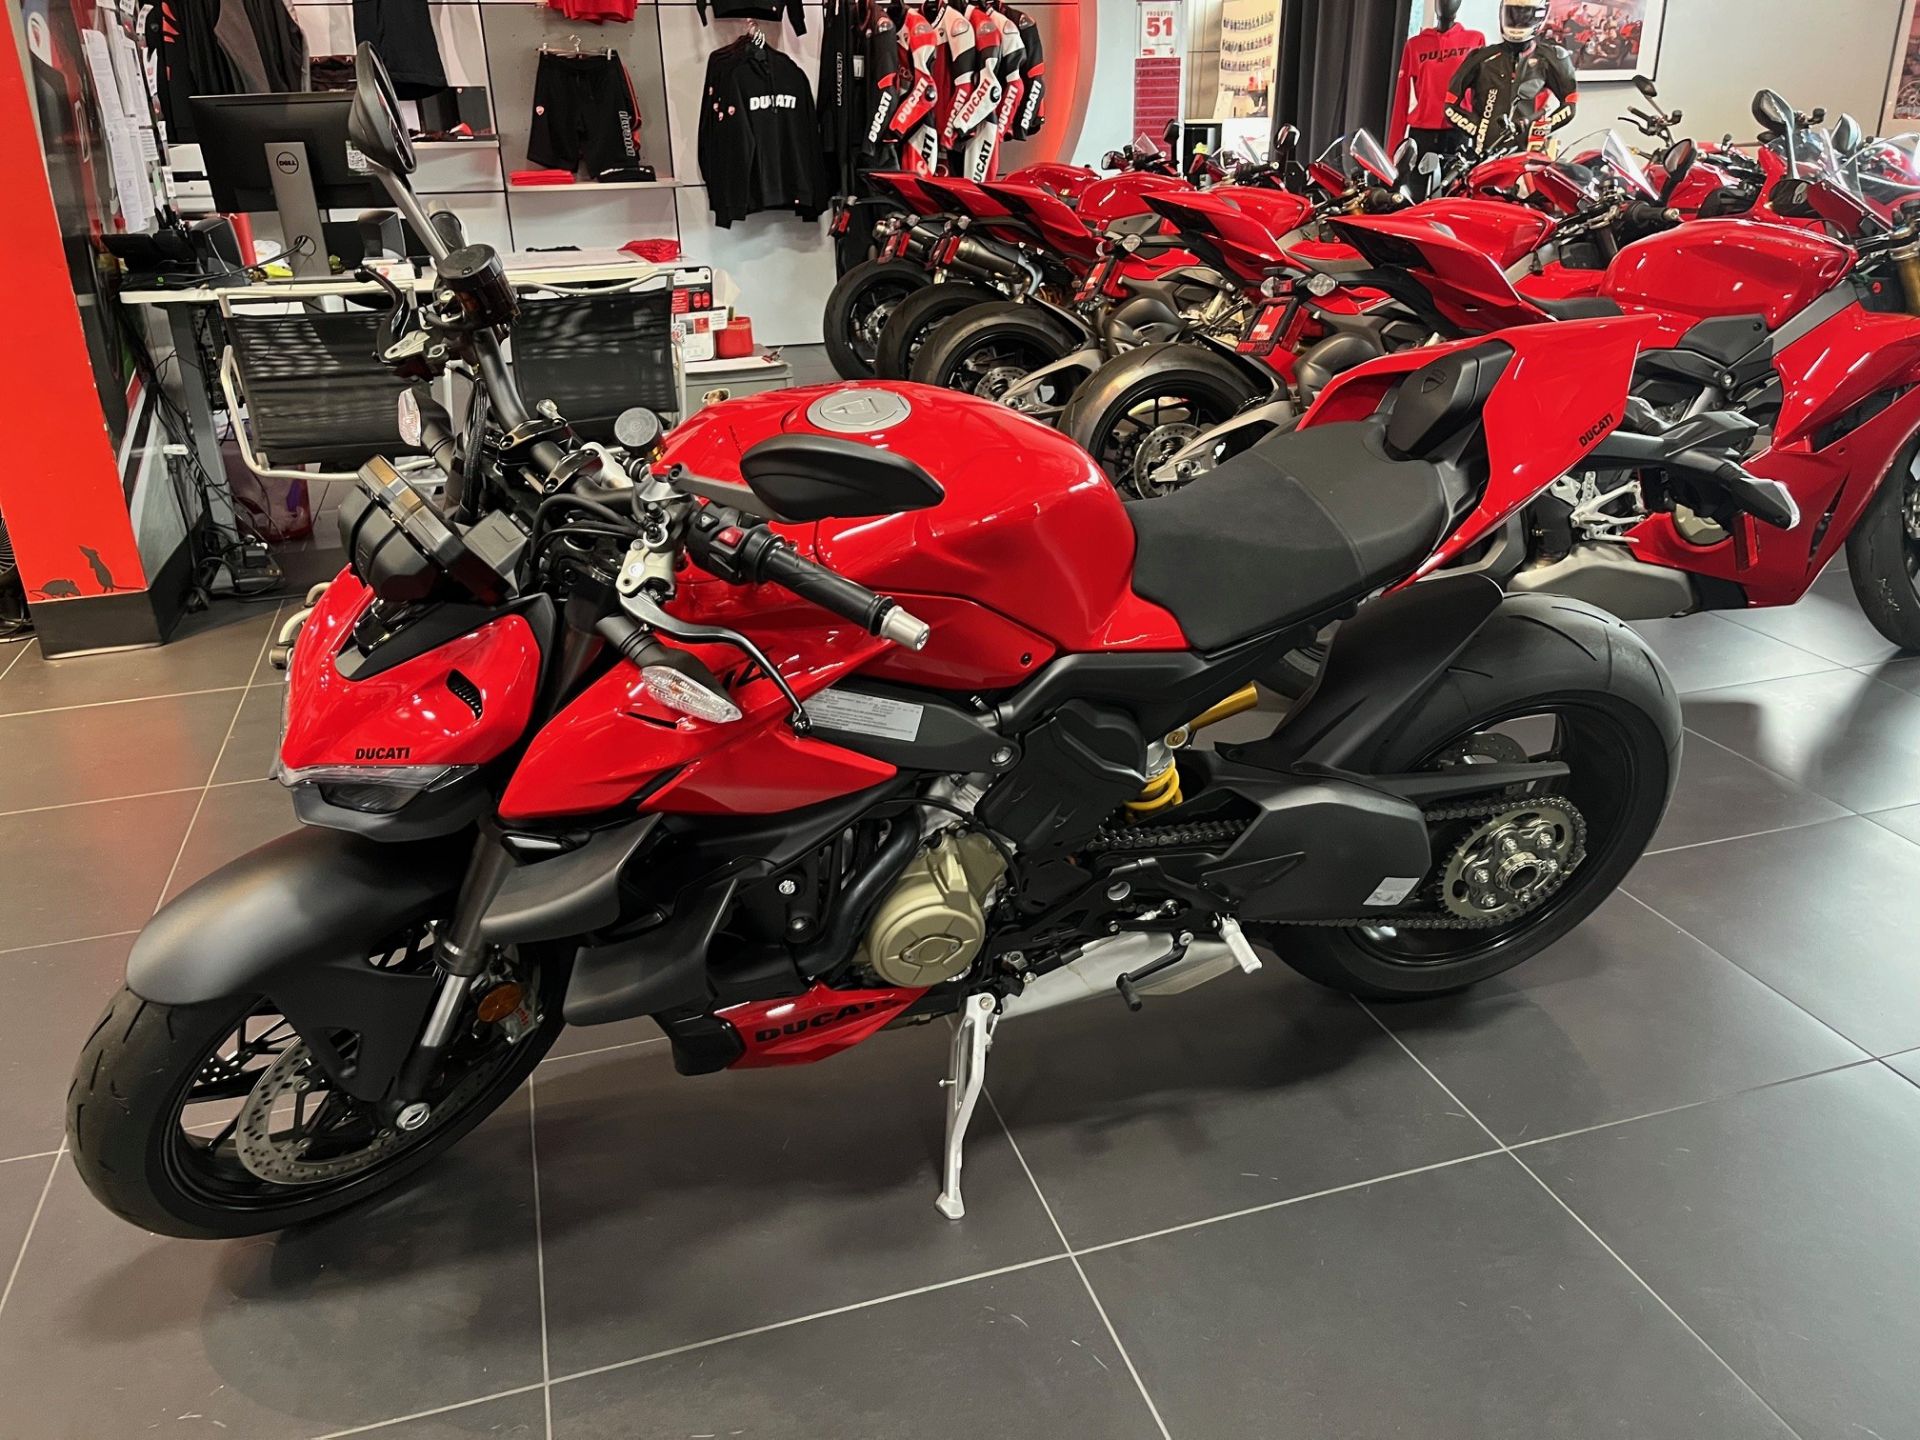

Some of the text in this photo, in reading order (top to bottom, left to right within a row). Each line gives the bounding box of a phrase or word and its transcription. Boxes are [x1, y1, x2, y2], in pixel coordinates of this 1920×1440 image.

[1146, 17, 1173, 37] 51
[1419, 47, 1470, 63] DUCAT
[867, 90, 893, 143] DUCATI
[897, 78, 929, 125] DUCATI
[961, 78, 991, 123] DUCATI
[1020, 80, 1042, 130] DUCATI
[1483, 88, 1499, 118] CORSE
[916, 133, 936, 177] CATI
[973, 139, 992, 182] UCATI
[1578, 413, 1614, 448] DUCATI
[355, 747, 411, 760] DUCATI
